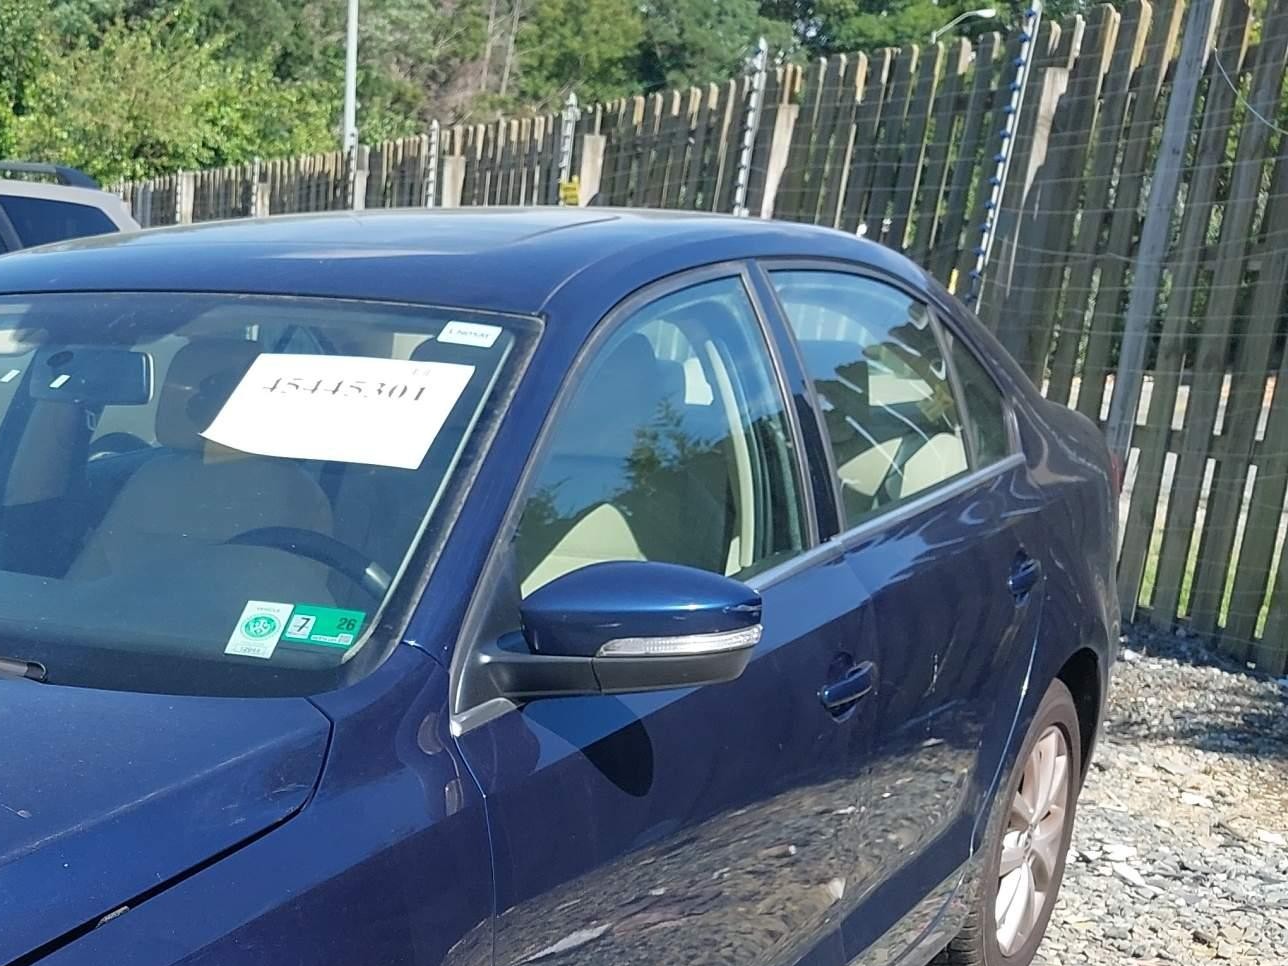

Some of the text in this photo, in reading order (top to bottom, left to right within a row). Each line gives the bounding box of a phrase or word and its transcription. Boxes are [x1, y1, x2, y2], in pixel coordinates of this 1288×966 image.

[262, 376, 426, 401] 45445301
[297, 616, 357, 632] 7 26
